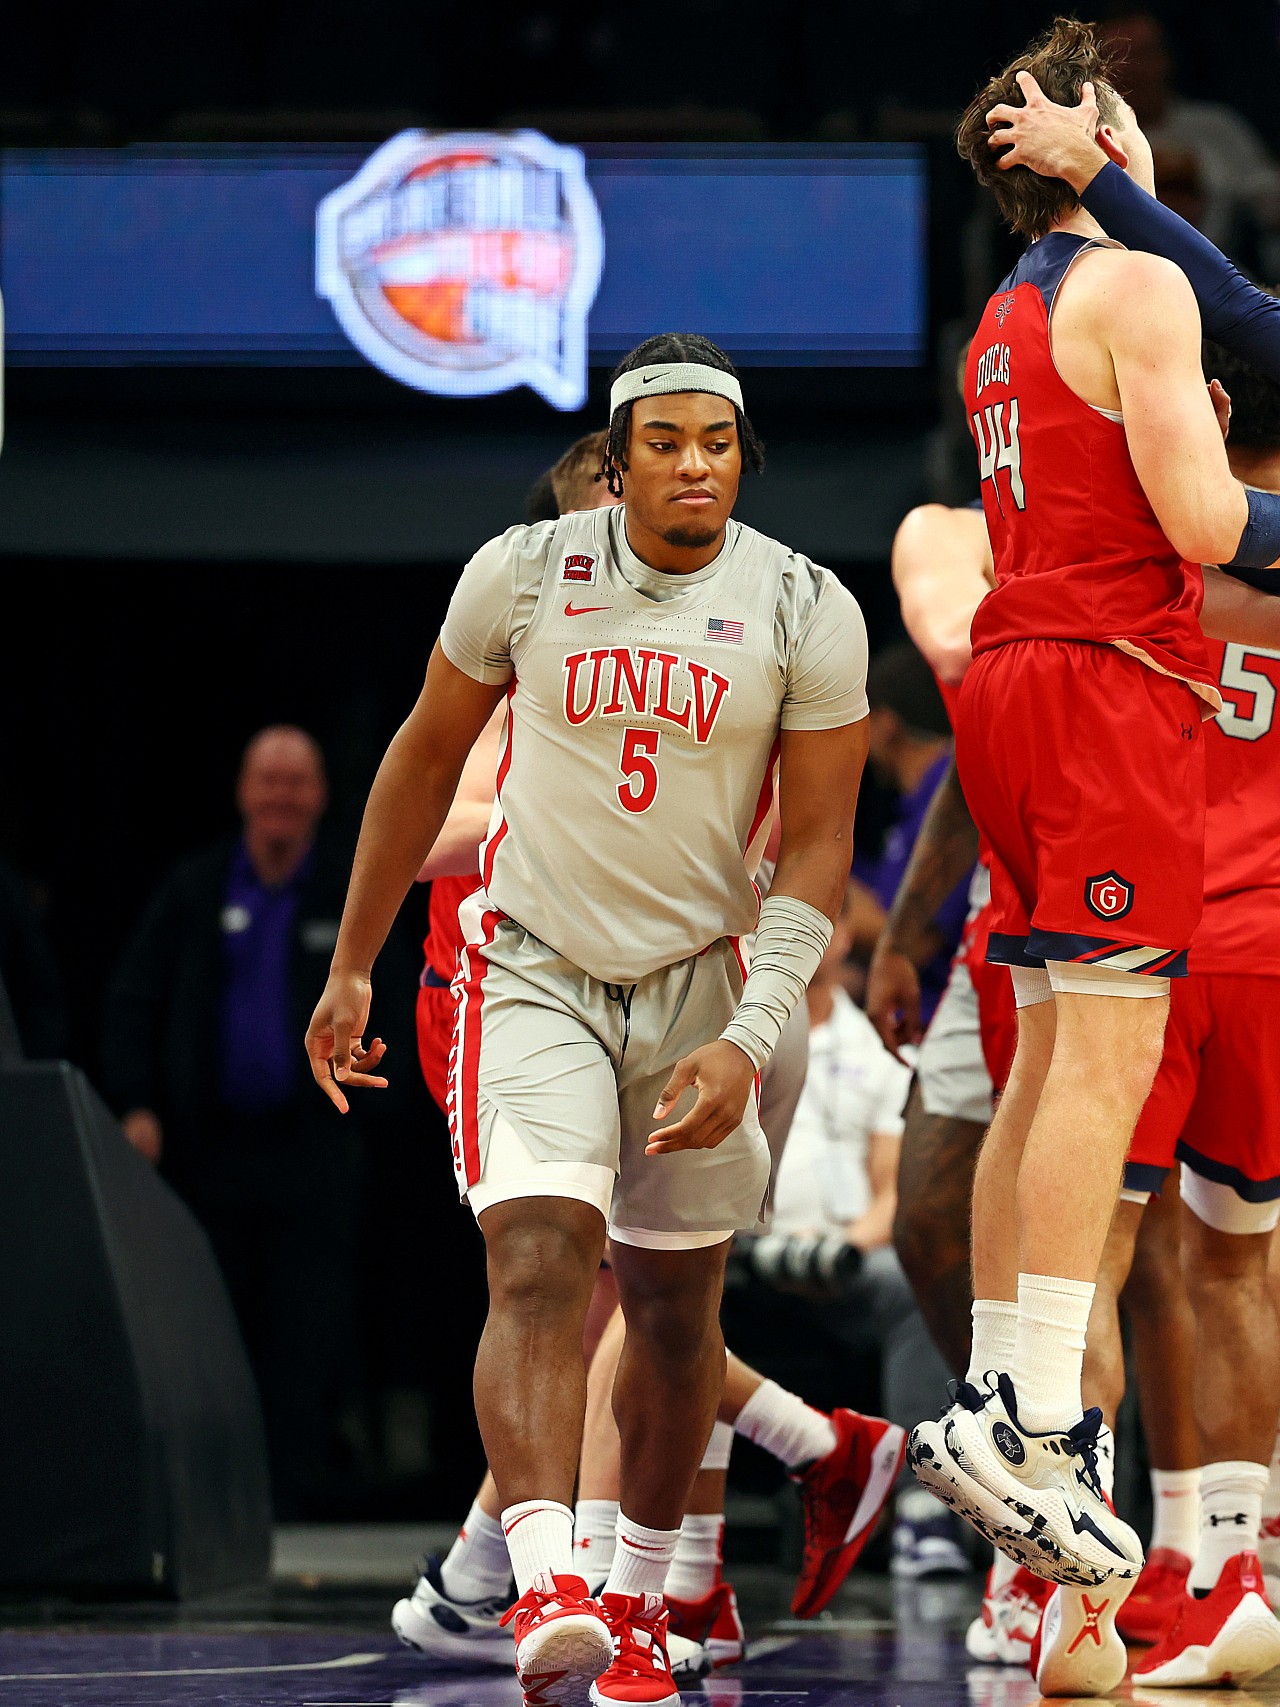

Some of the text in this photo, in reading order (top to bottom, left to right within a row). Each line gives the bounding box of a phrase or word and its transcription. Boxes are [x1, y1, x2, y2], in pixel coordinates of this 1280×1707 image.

[976, 342, 1011, 398] DUCAS
[972, 397, 1026, 512] 44
[563, 646, 732, 744] UNLV
[616, 726, 662, 815] 5
[1099, 885, 1117, 910] G
